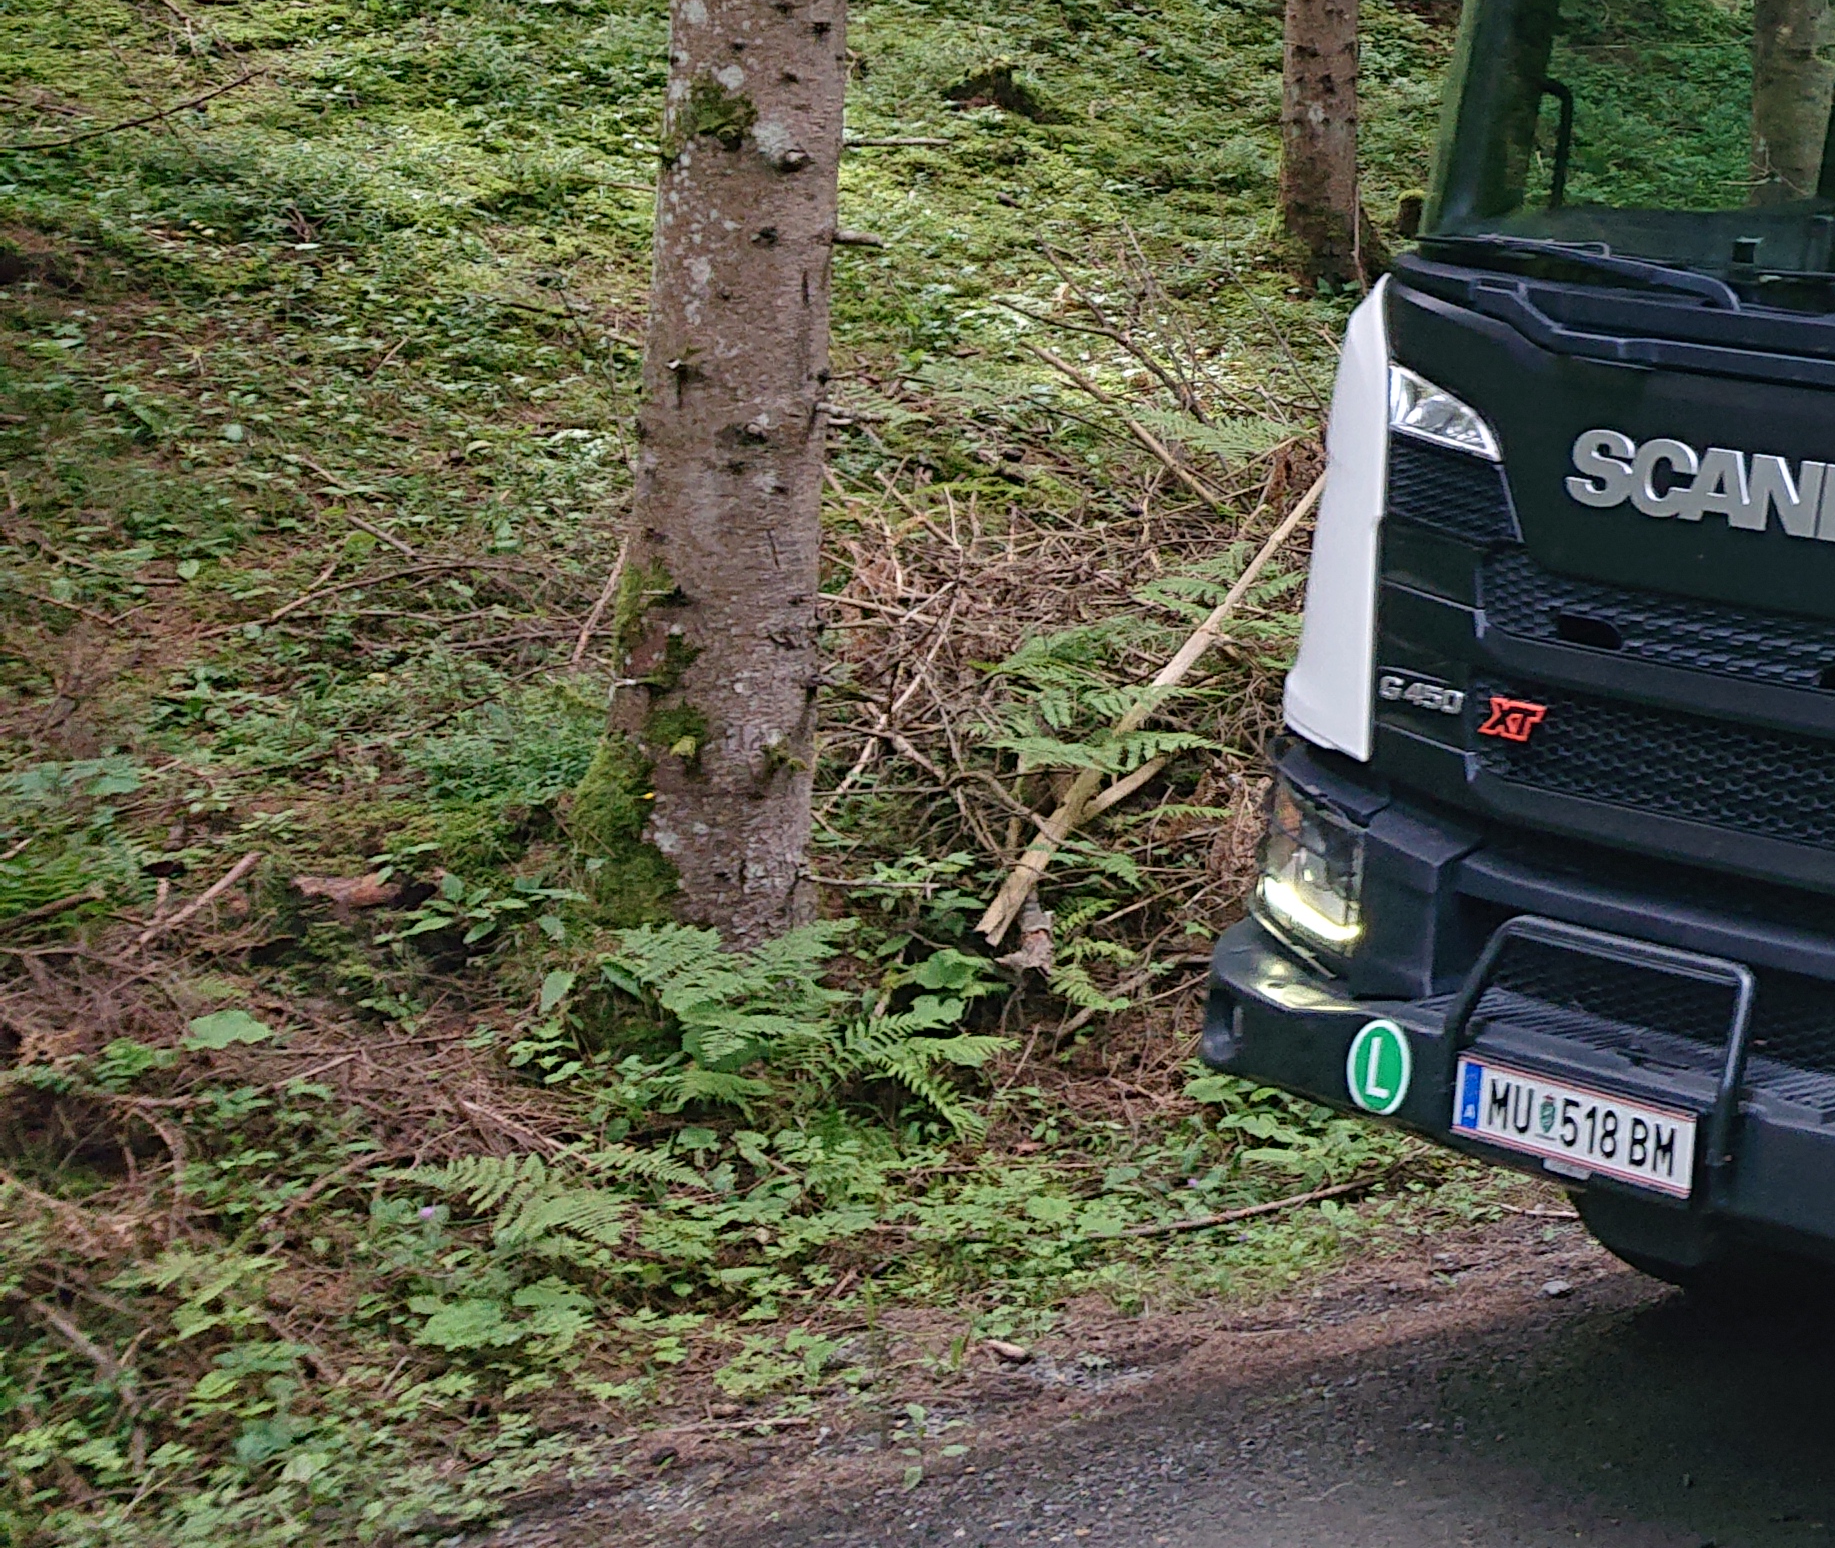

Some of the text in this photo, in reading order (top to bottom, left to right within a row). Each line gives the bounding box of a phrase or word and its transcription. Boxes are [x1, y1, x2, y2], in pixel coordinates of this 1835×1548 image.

[1379, 675, 1466, 715] G 450
[1477, 696, 1548, 743] XT
[1365, 1036, 1390, 1100] L
[1488, 1078, 1677, 1178] MU 518 BM
